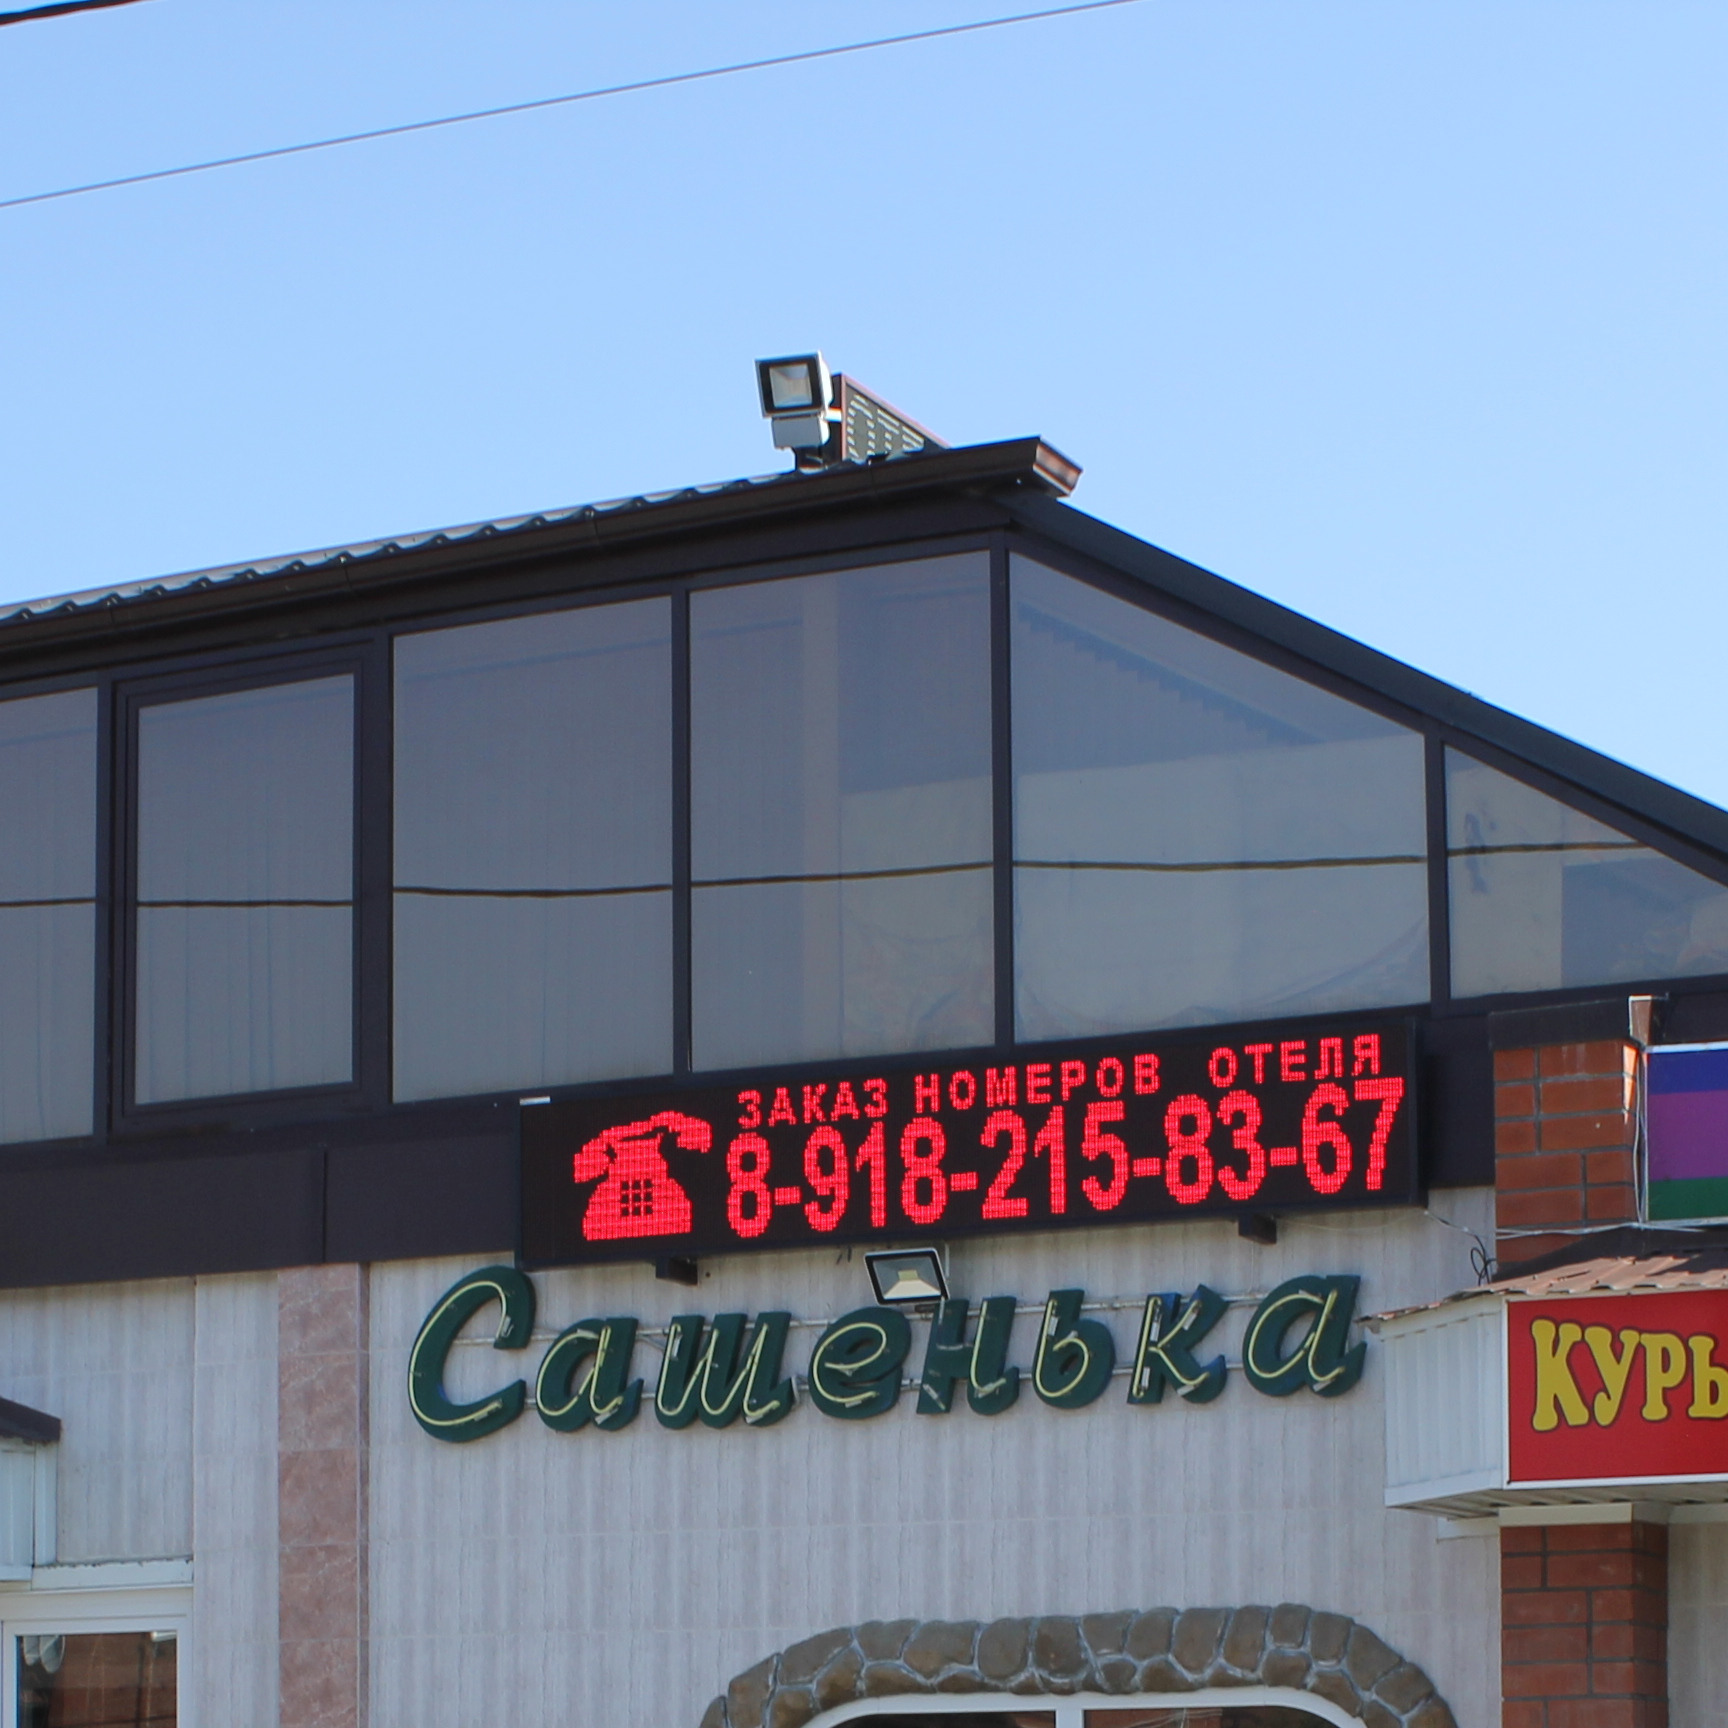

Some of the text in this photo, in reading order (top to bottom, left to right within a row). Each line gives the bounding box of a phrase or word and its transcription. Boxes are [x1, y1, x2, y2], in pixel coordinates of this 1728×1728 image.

[726, 1076, 1405, 1239] 8-918-215-83-67
[737, 1032, 1381, 1129] ЗАКАЗ НОМЕРОВ ОТЕЛЯ
[407, 1265, 1369, 1442] Сашенька
